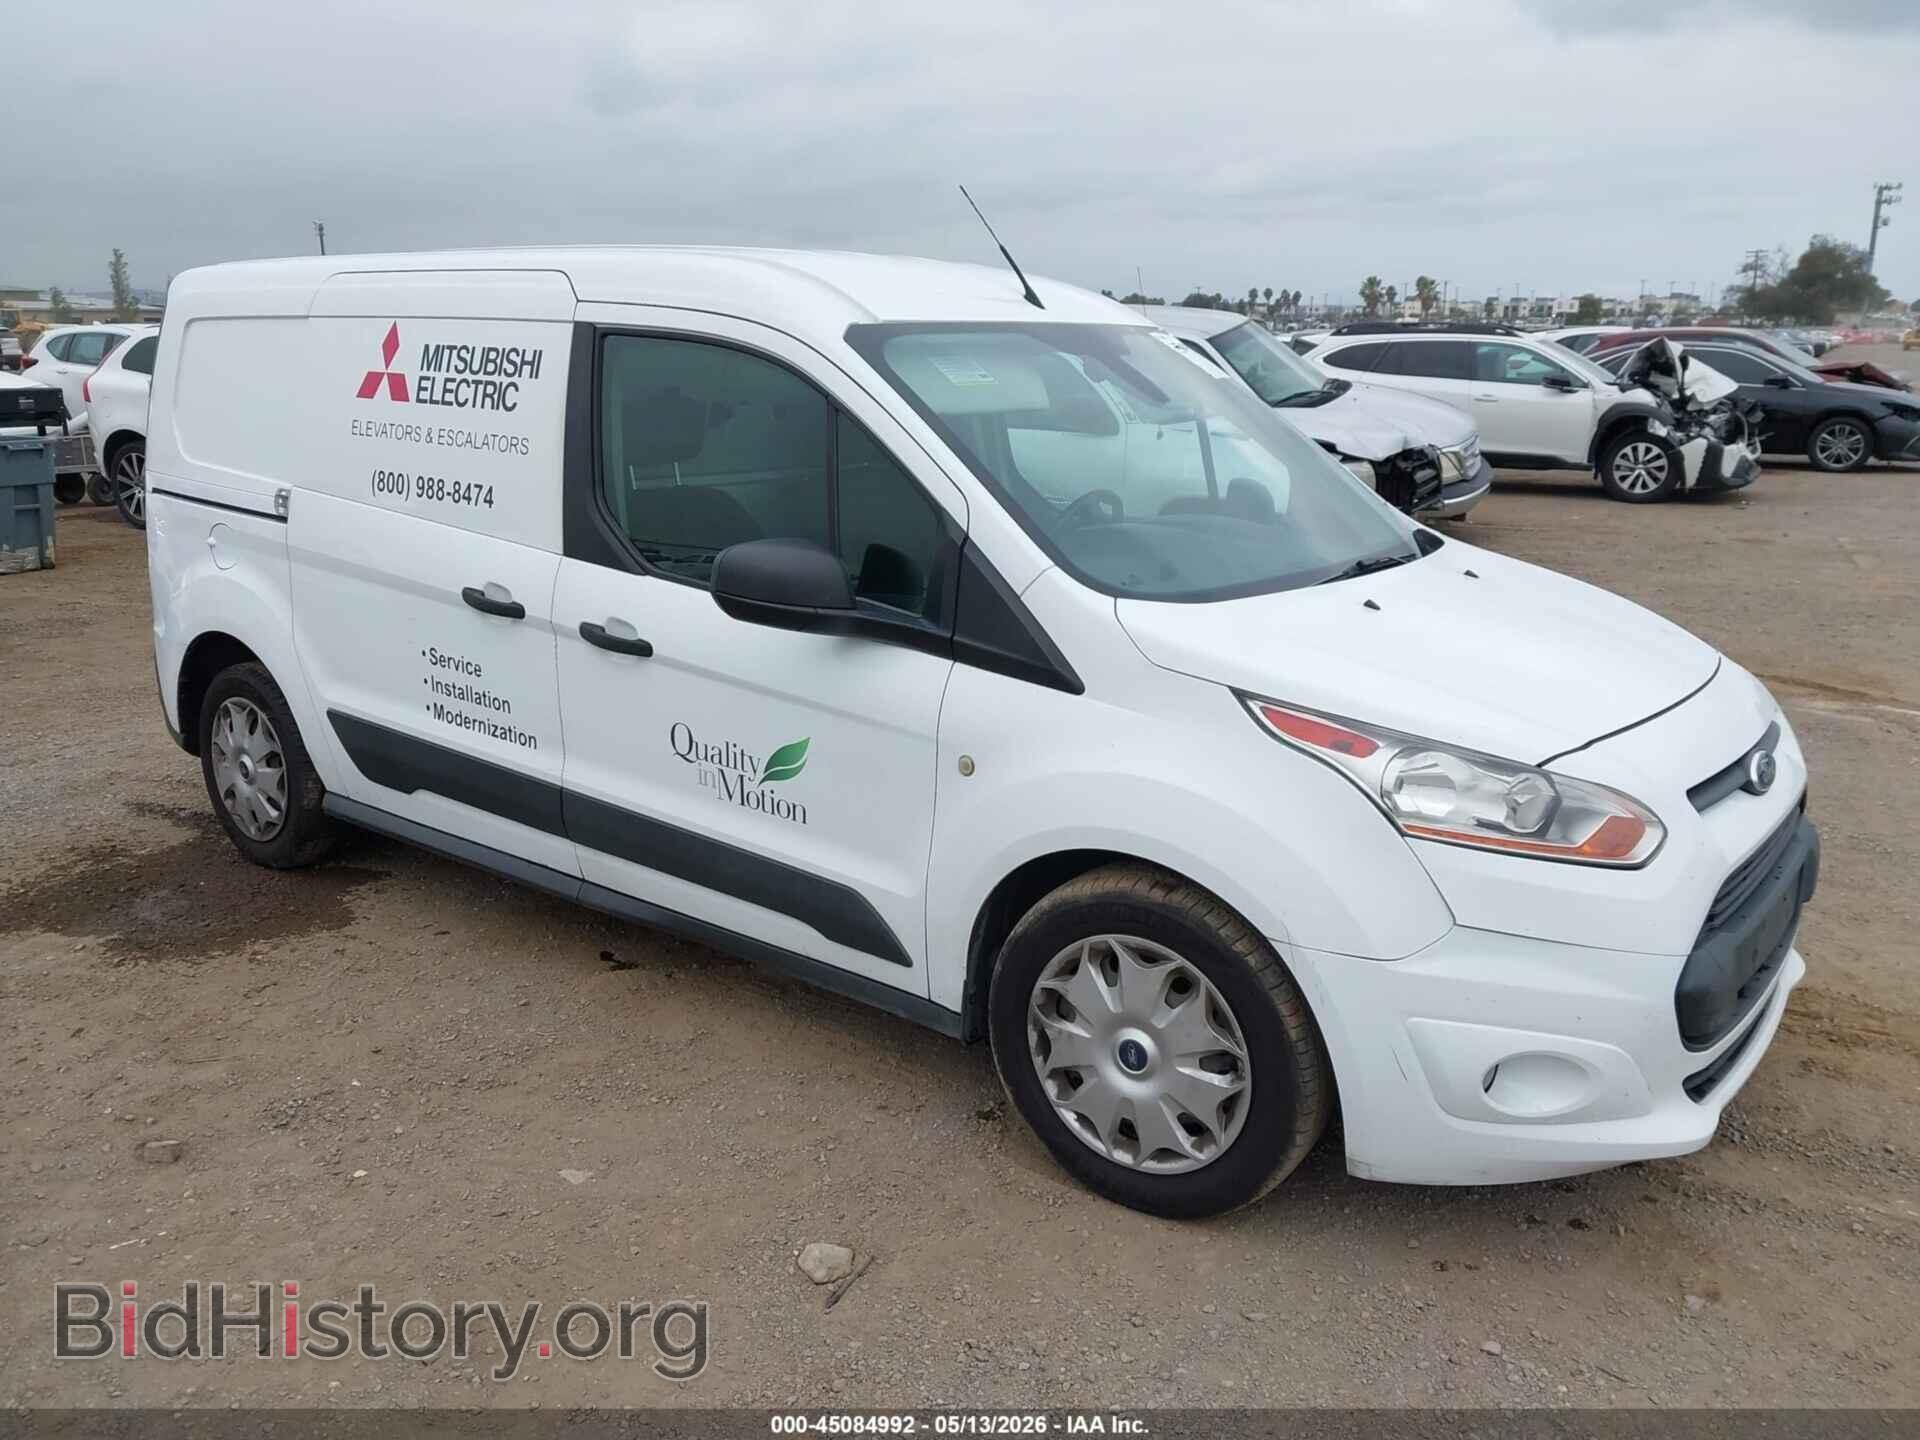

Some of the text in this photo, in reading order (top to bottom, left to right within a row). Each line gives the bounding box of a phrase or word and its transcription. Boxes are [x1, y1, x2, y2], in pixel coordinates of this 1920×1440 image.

[420, 344, 543, 380] MITSUBISHI
[415, 376, 519, 412] ELECTRIC
[351, 419, 530, 456] ELEVATORS & ESCALATORS
[371, 469, 494, 509] (800) 988-8474
[429, 647, 482, 678] Service
[431, 675, 511, 714] Installation
[433, 702, 537, 750] Modernization
[670, 721, 760, 782] Quality
[697, 763, 717, 789] in
[716, 767, 807, 825] Motion
